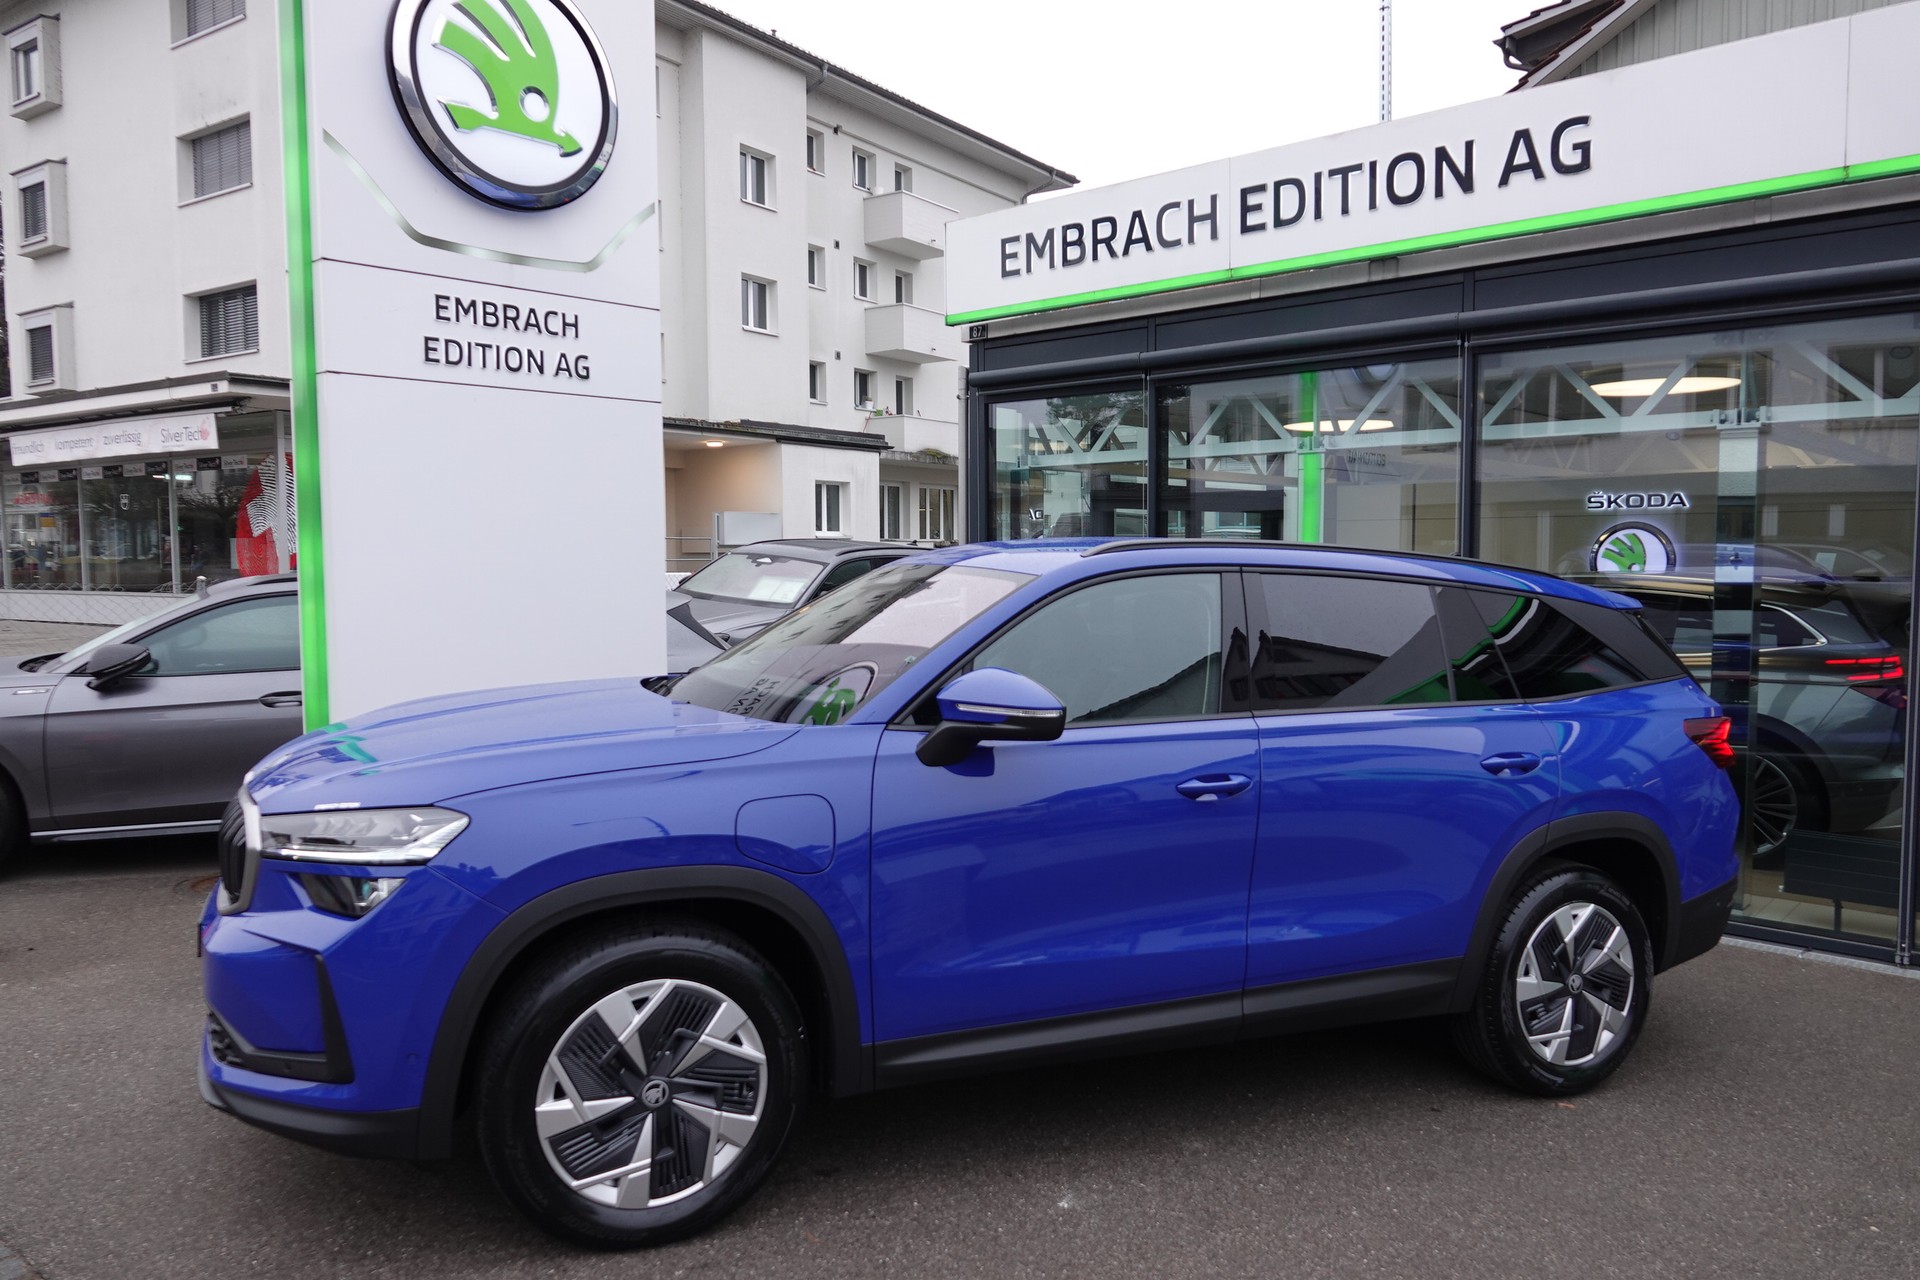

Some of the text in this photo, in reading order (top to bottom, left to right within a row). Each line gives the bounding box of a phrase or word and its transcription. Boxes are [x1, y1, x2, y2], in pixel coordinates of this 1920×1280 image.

[1000, 115, 1593, 279] EMBRACH EDITION AG
[434, 294, 579, 339] EMBRACH
[972, 326, 982, 338] 87
[424, 336, 591, 380] EDITION AG
[1587, 491, 1690, 510] ŠKODA
